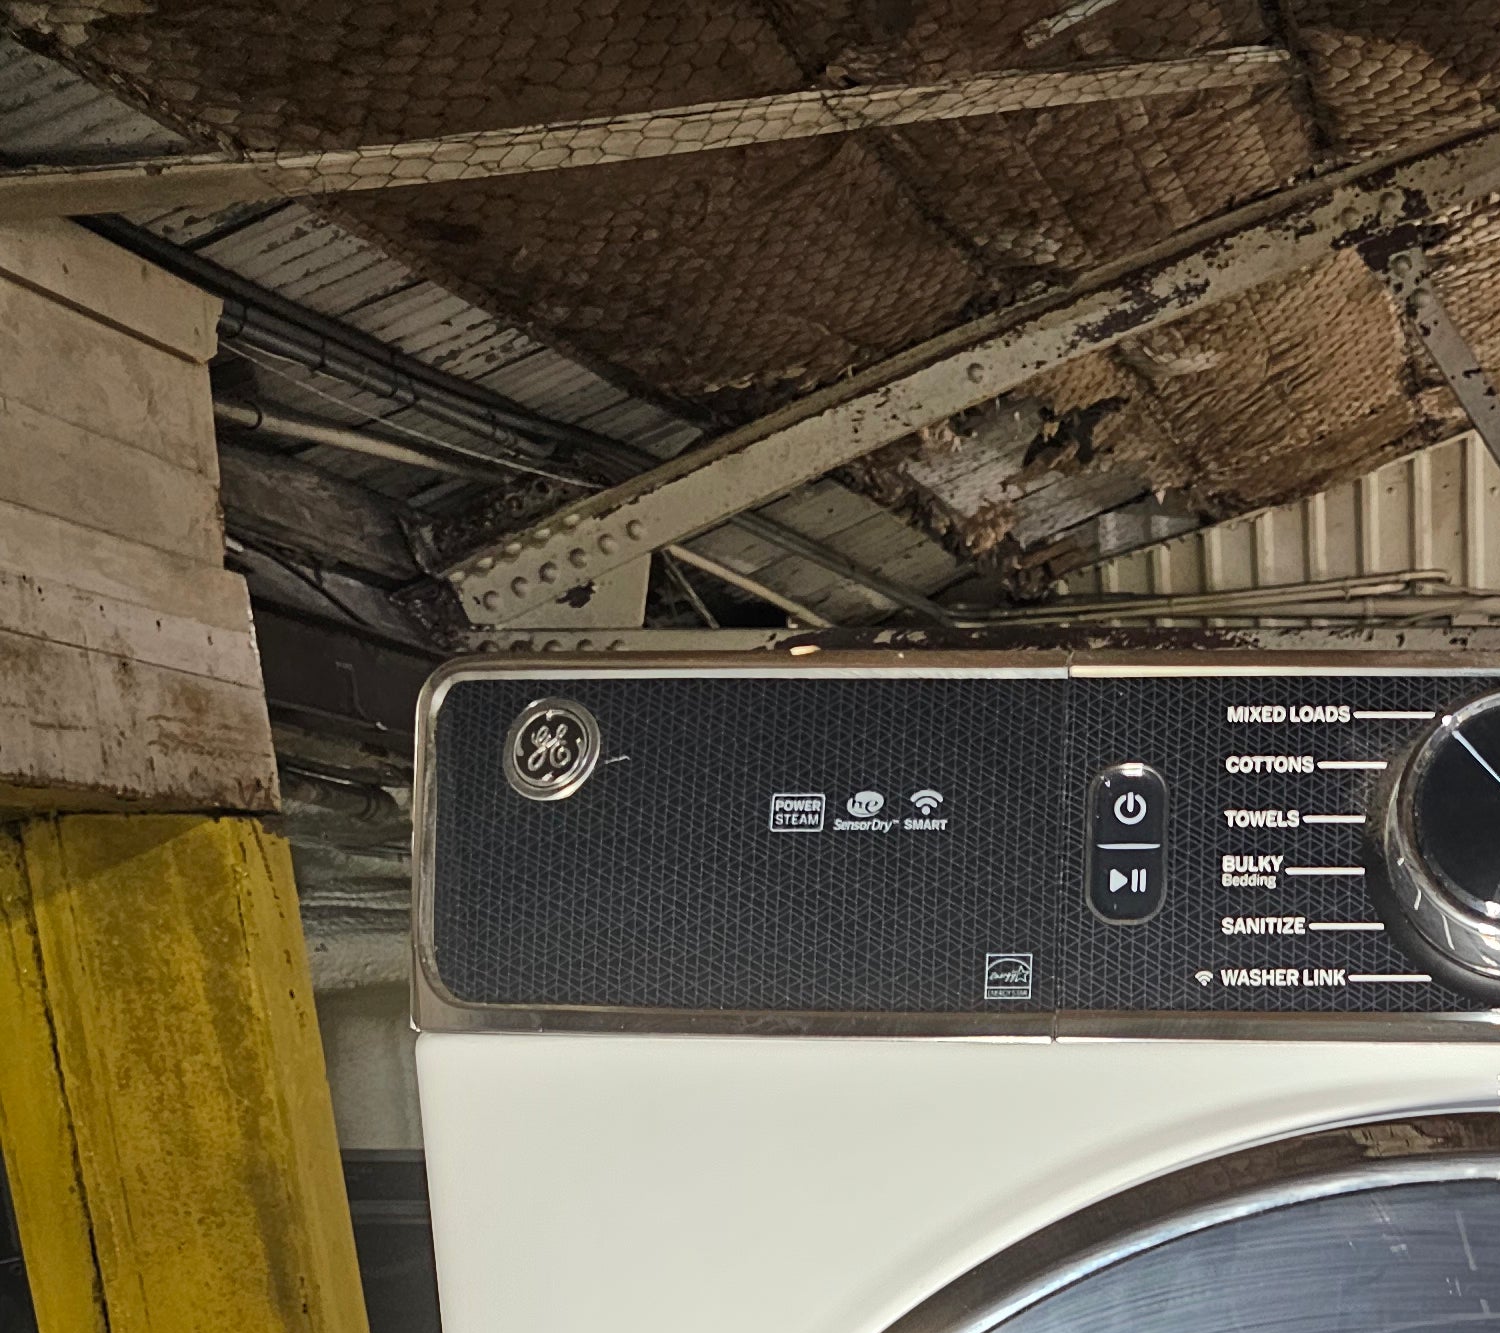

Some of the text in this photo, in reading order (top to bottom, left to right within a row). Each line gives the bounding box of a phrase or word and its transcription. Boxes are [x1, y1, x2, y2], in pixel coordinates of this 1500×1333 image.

[1227, 705, 1351, 723] MIXED LOADS
[1225, 756, 1314, 774] COTTONS
[775, 799, 822, 812] POWER
[775, 813, 819, 825] STEAM
[904, 818, 948, 831] SMART
[1224, 809, 1300, 828] TOWELS
[1222, 855, 1284, 873] BULKY
[1222, 873, 1277, 889] Bedding
[1221, 917, 1306, 935] SANITIZE
[1220, 969, 1346, 987] WASHER LINK
